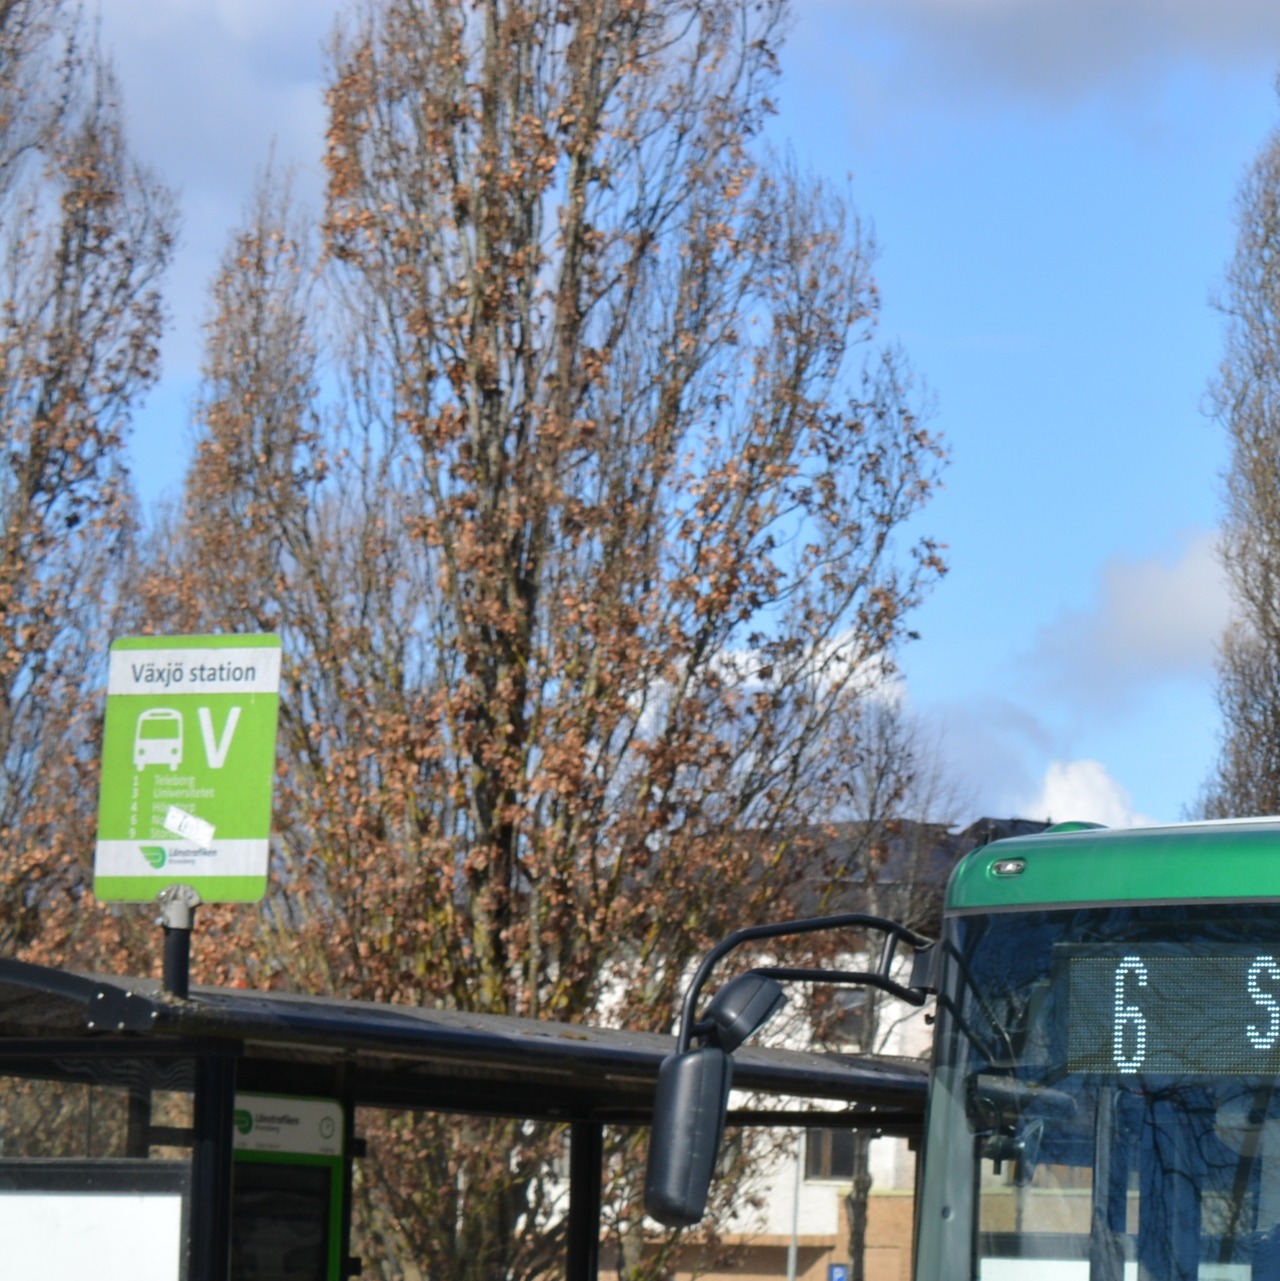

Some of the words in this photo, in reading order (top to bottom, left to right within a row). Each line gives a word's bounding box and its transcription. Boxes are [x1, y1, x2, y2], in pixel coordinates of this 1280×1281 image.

[131, 662, 184, 687] Växjö
[189, 661, 256, 683] station
[198, 706, 242, 769] V
[1113, 955, 1148, 1074] 6
